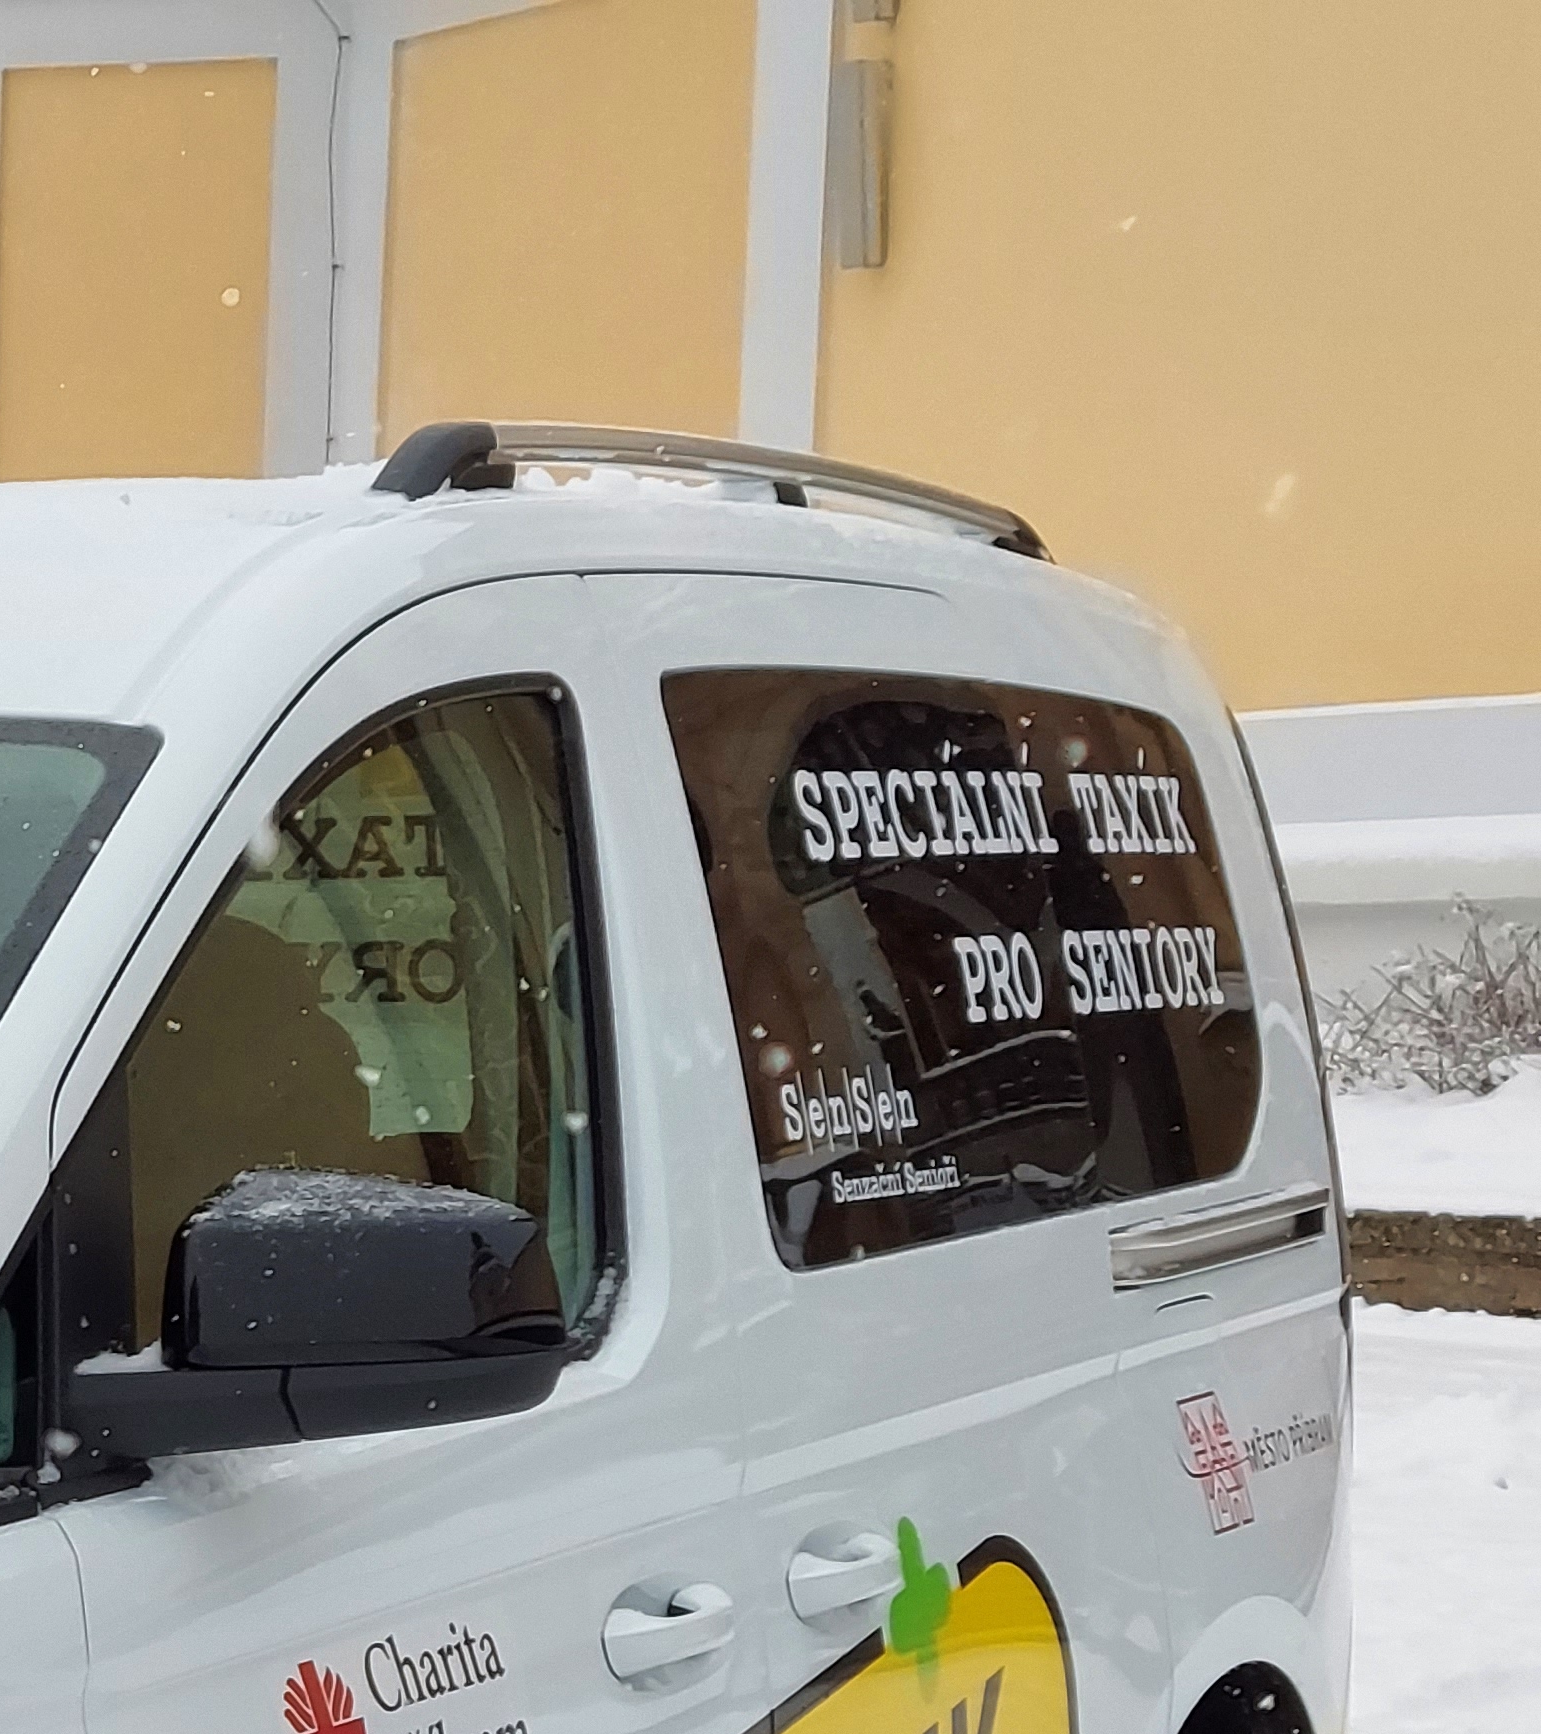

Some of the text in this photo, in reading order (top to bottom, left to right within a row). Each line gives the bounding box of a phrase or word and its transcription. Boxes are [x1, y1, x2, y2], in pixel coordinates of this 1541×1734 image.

[793, 739, 1197, 862] SPECIÁLNÍ TAXÍK
[953, 926, 1225, 1023] PRO SENIORY
[363, 1621, 505, 1713] Charita
